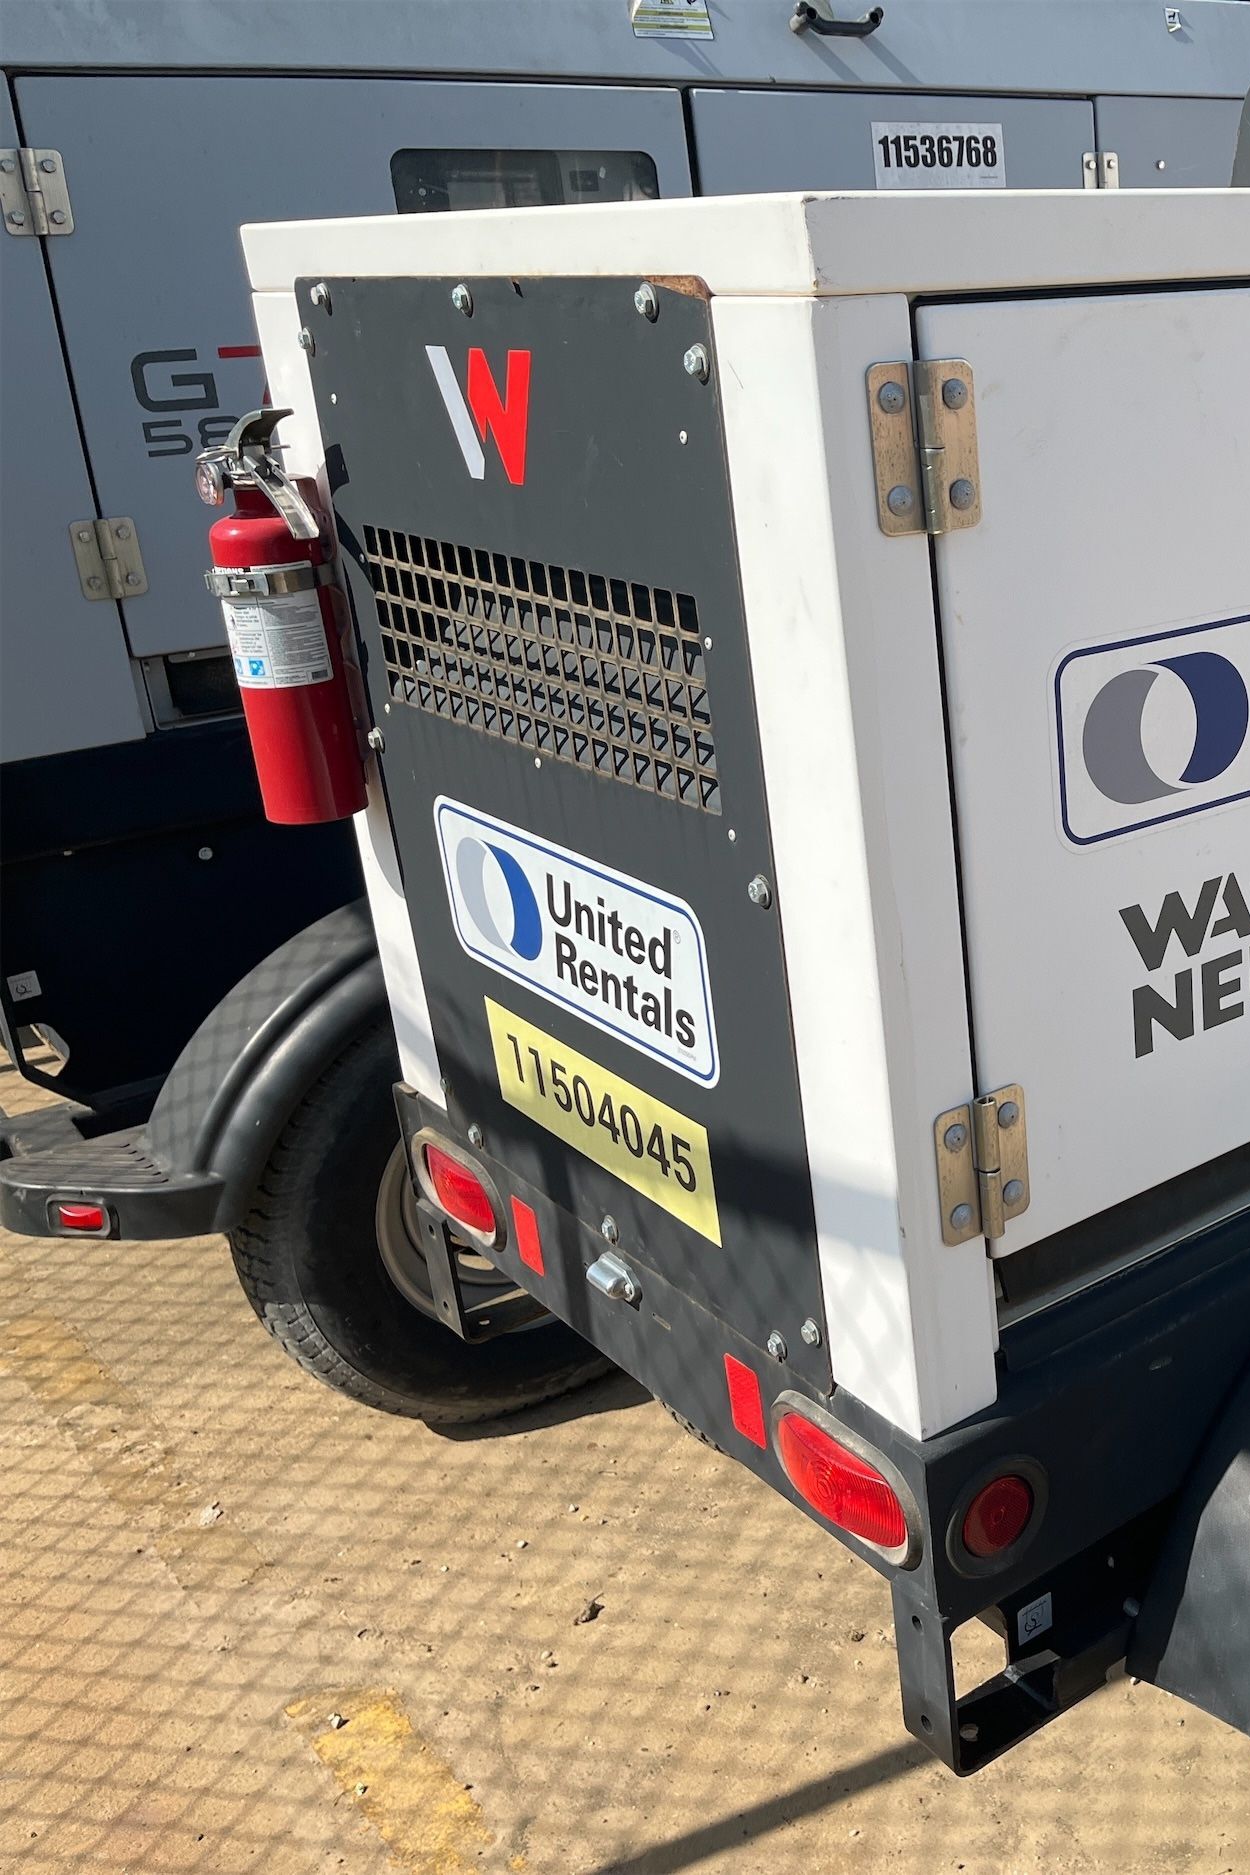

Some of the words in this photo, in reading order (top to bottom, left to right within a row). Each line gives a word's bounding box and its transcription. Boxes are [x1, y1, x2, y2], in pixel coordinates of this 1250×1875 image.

[878, 134, 998, 168] 11536768
[545, 872, 673, 980] United
[554, 932, 697, 1049] Rentals
[506, 1033, 697, 1194] 11504045
